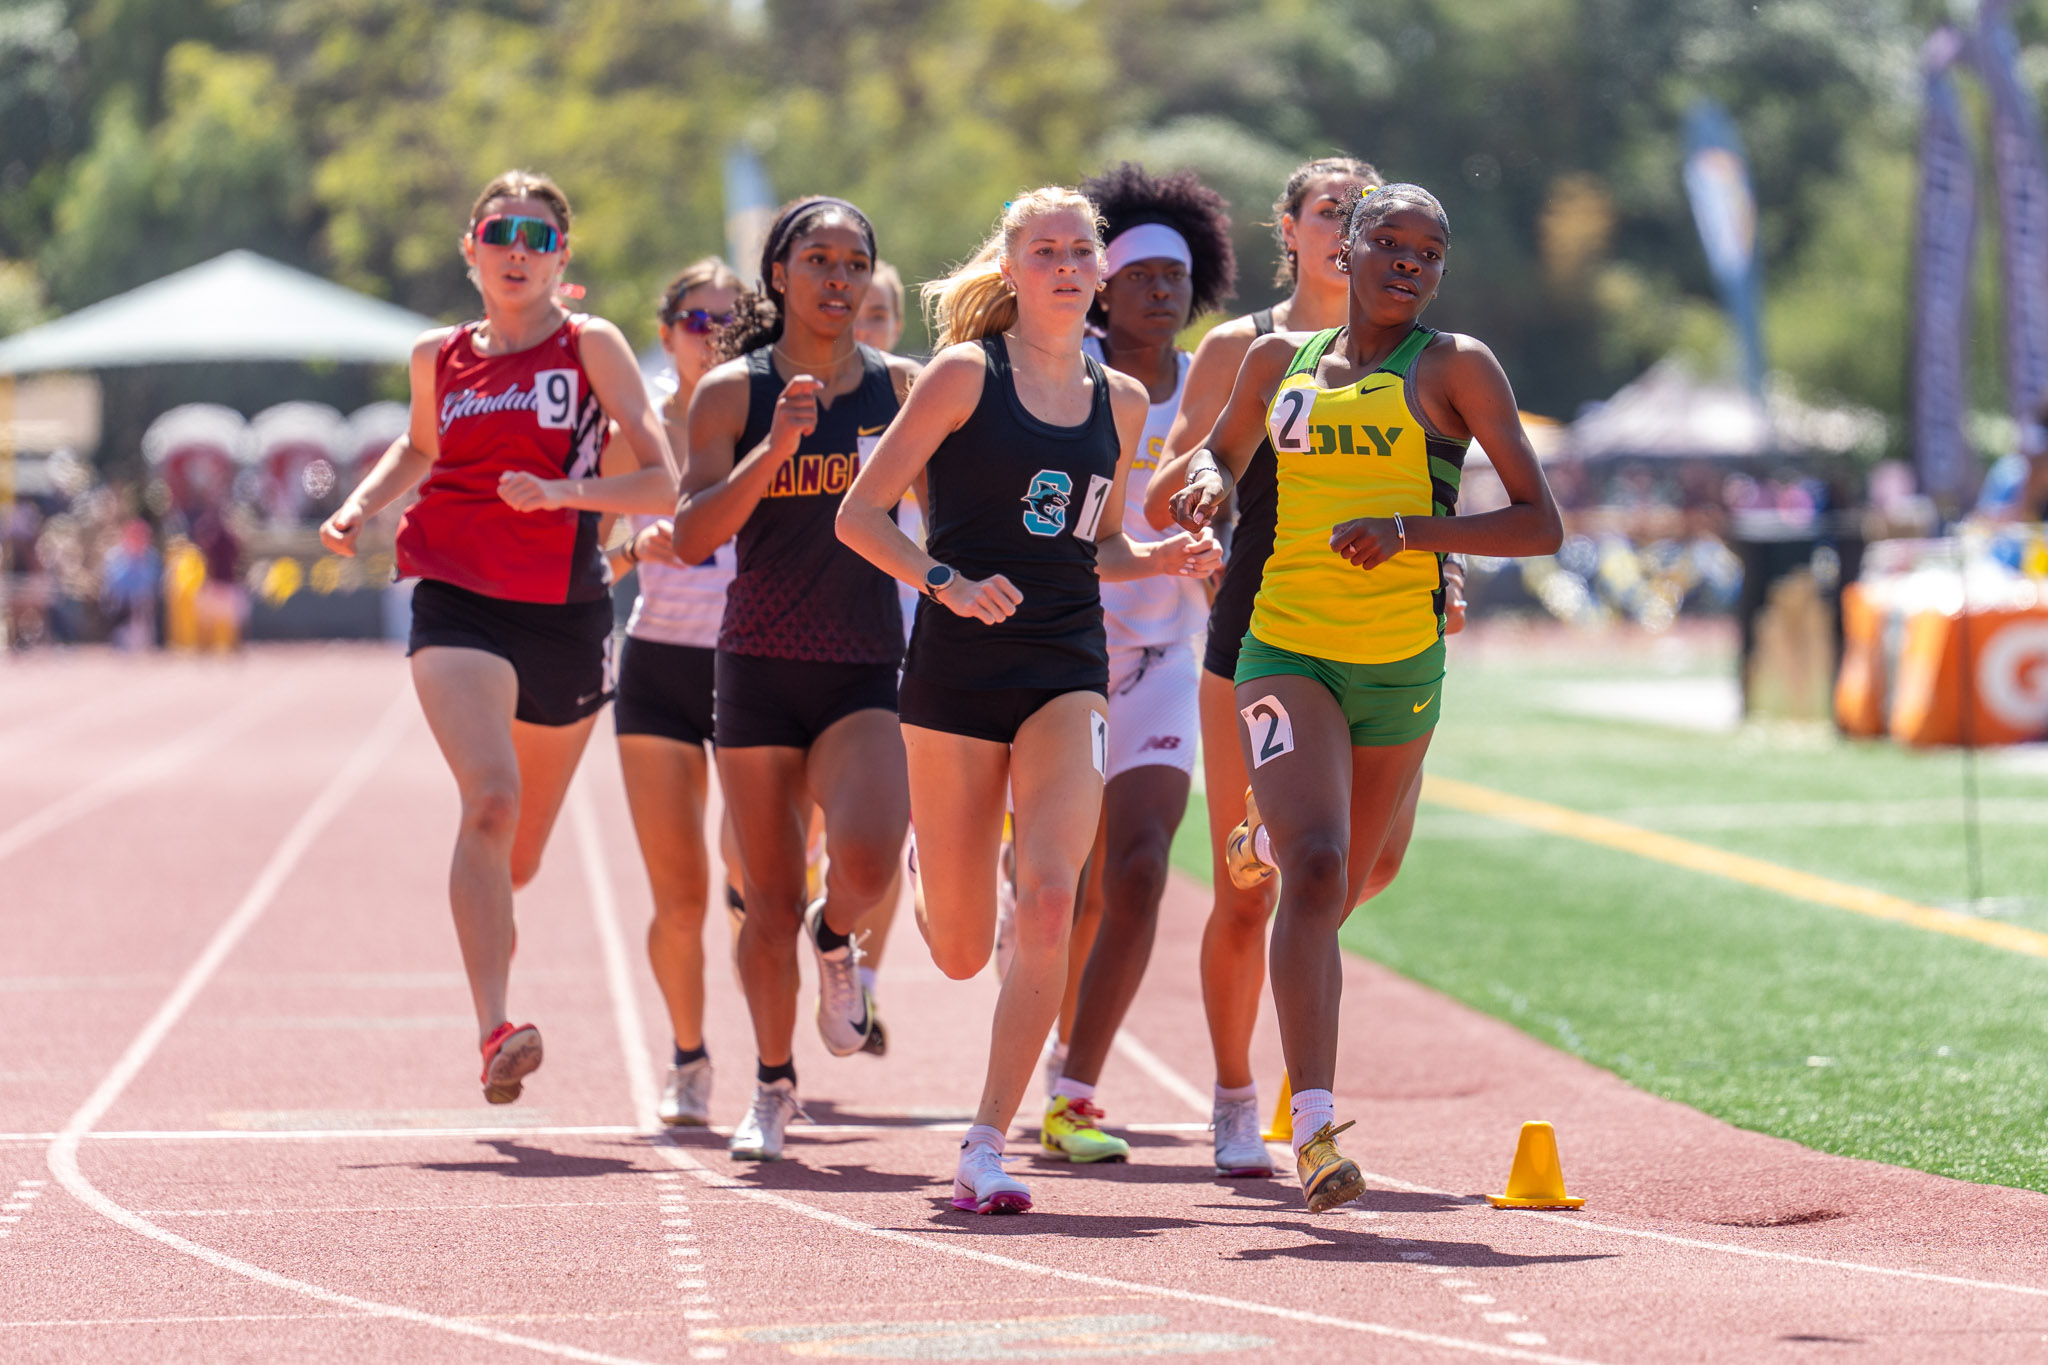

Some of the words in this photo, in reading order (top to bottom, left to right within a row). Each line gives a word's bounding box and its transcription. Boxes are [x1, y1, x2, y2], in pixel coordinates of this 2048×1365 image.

[547, 373, 570, 423] 9
[1278, 391, 1304, 449] 2
[1272, 424, 1404, 457] OLY
[762, 452, 861, 498] ANC
[1086, 482, 1109, 537] 1
[1098, 720, 1105, 776] 1
[1251, 703, 1284, 762] 2
